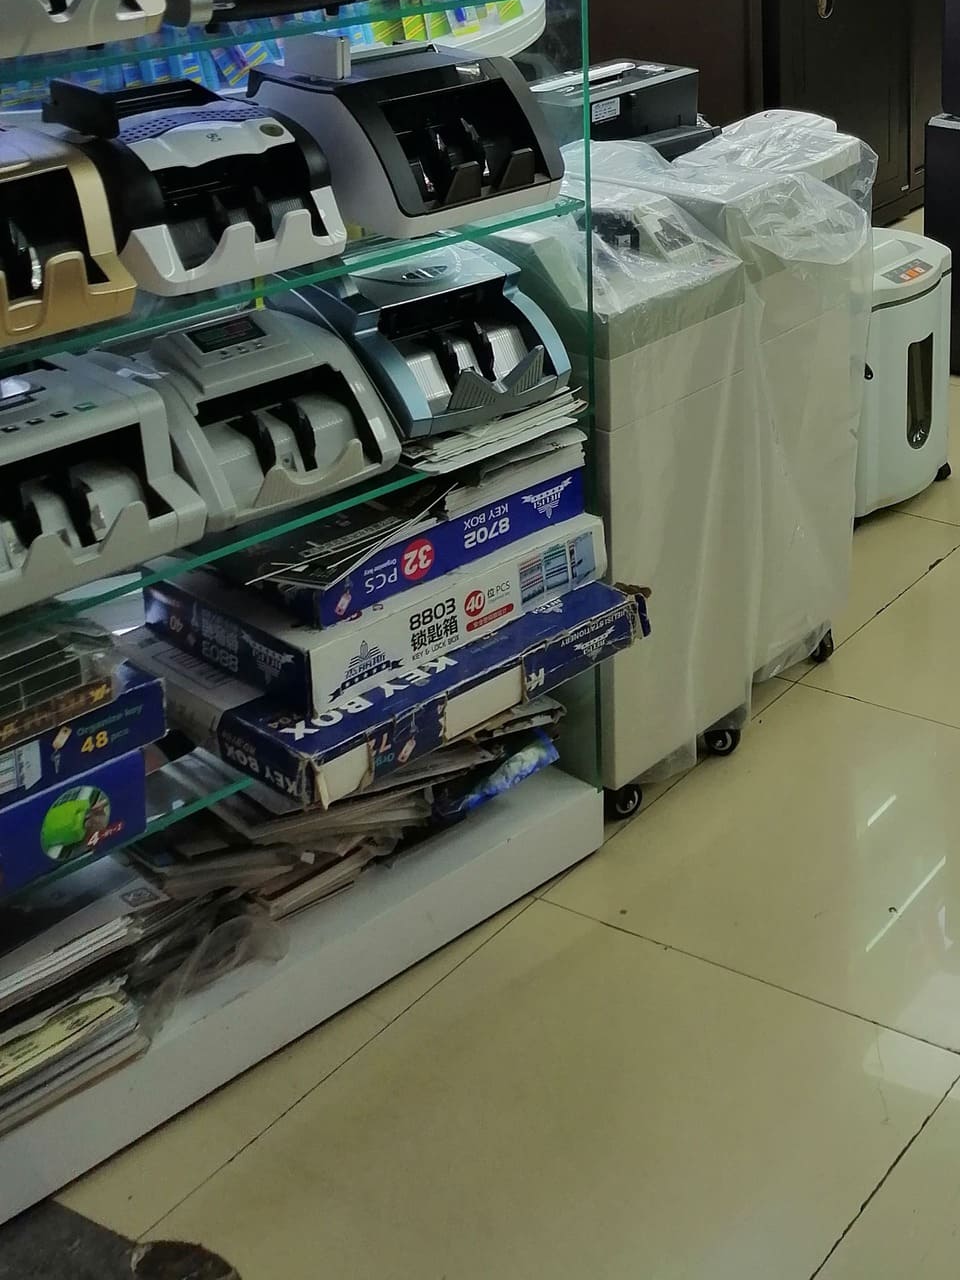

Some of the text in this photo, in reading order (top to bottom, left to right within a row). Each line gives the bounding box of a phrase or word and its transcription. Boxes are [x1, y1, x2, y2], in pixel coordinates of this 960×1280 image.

[463, 504, 509, 532] KEY BOX
[464, 518, 510, 549] 8702
[365, 544, 433, 594] 32 PCS
[409, 597, 456, 631] 8803
[465, 596, 484, 613] 40
[495, 581, 511, 596] PCS
[411, 615, 459, 652] 锁匙箱
[378, 655, 459, 698] KEY
[280, 695, 374, 741] BOX
[81, 730, 109, 752] 48
[226, 744, 299, 797] KEY BOX
